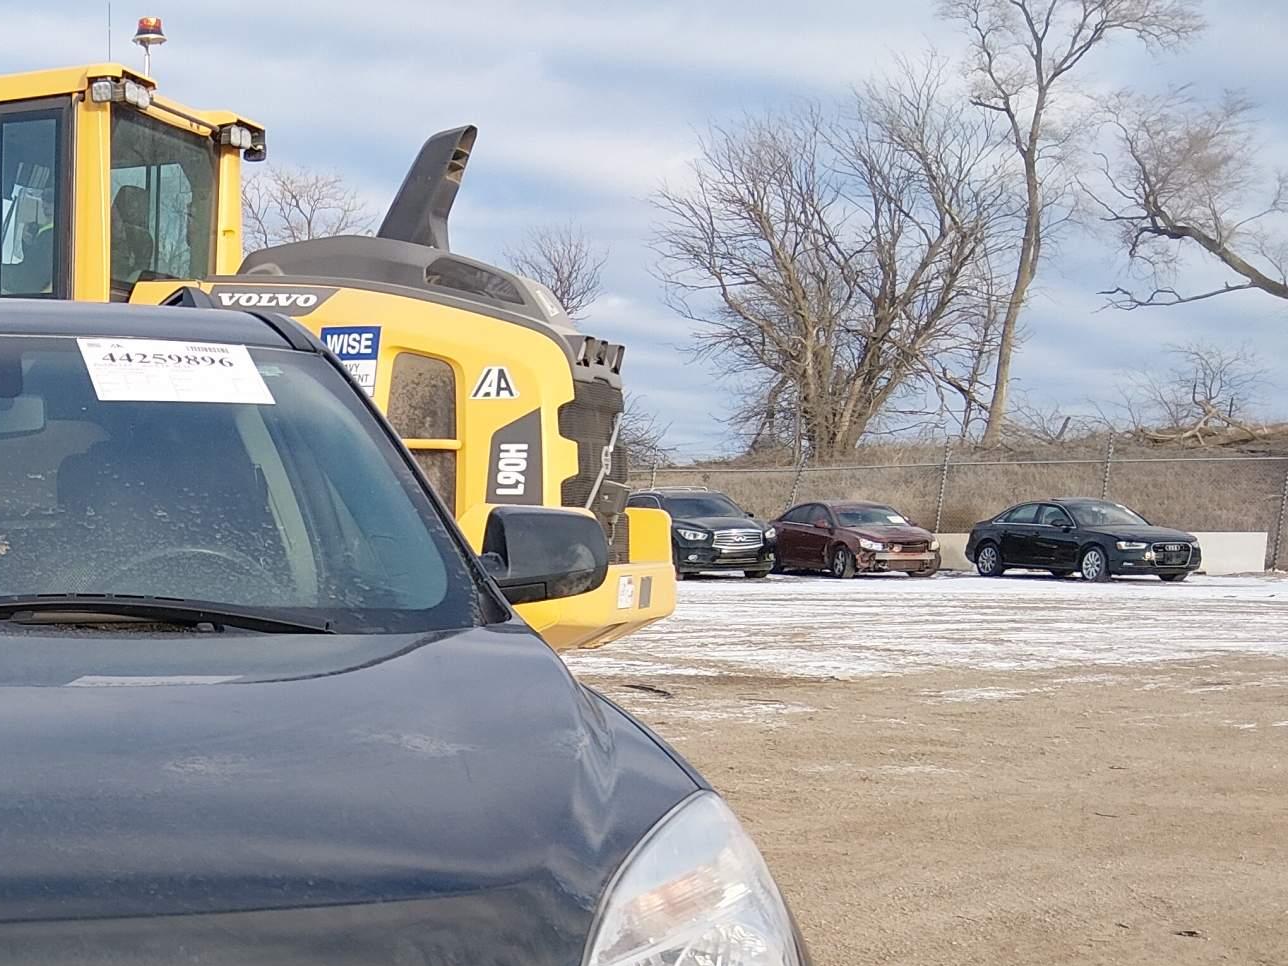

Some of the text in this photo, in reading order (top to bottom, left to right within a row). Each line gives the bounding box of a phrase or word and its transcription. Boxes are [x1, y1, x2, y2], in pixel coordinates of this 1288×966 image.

[218, 293, 317, 307] VOLVO
[326, 333, 373, 354] WISE
[102, 352, 234, 367] 44259896
[496, 443, 529, 495] L90H
